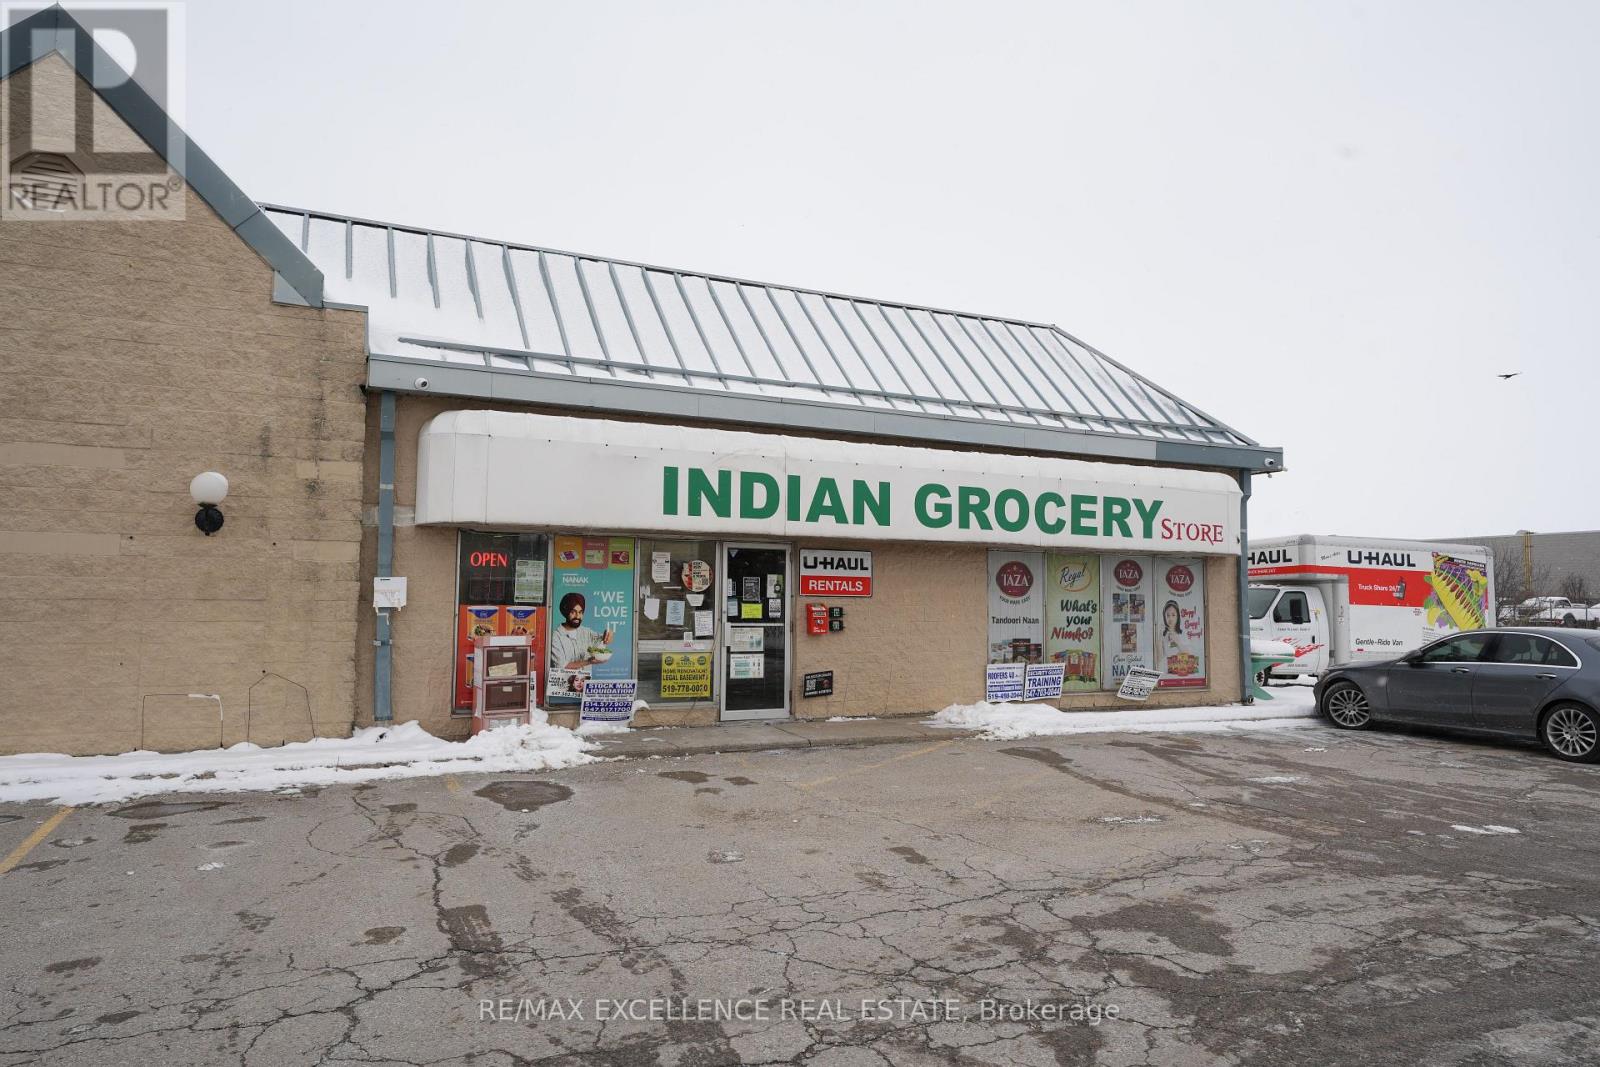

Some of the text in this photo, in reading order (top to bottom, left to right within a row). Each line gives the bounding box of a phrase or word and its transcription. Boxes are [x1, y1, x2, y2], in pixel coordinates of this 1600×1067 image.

[664, 467, 1162, 538] INDIAN GROCERY
[470, 551, 508, 568] OPEN
[1001, 573, 1031, 587] TAZA
[1059, 562, 1088, 588] Regal
[1119, 569, 1140, 579] TAZA
[1169, 574, 1191, 585] TAZA
[808, 579, 863, 592] RENTALS
[1373, 584, 1388, 592] Share
[594, 606, 628, 618] LOVE
[1060, 599, 1098, 614] What's
[992, 616, 1040, 625] Tandoori Naan
[1066, 615, 1093, 628] your
[1355, 638, 1403, 647] Gentle-Ride Van
[1028, 676, 1062, 688] TRAINING
